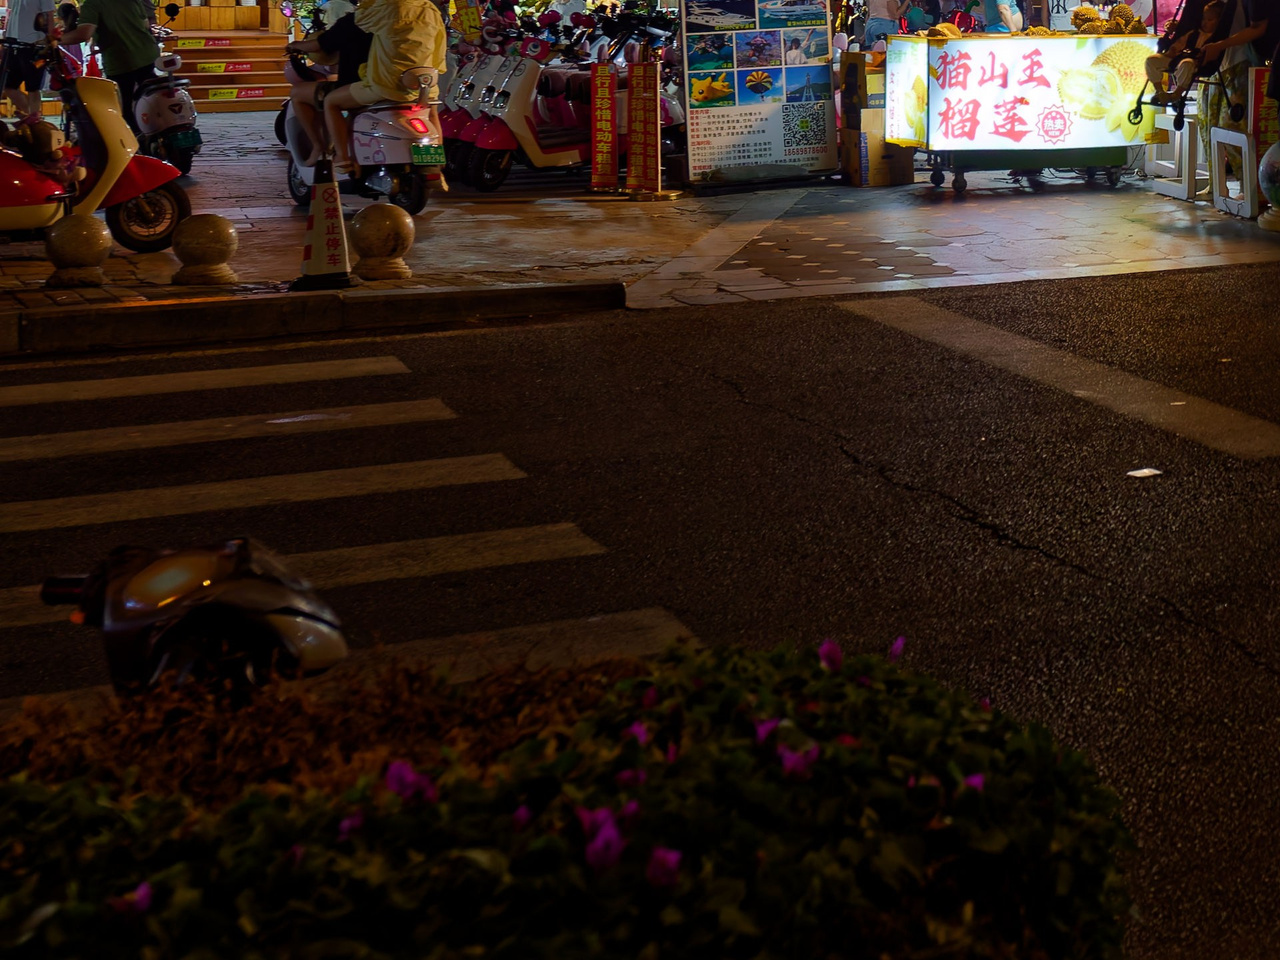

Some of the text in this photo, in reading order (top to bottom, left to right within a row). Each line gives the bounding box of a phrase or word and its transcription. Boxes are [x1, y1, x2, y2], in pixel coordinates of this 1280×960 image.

[937, 48, 1052, 90] 猫山王
[938, 96, 1033, 143] 榴莲
[1043, 118, 1065, 131] 热卖
[784, 146, 828, 157] 18689878600
[323, 207, 342, 267] 禁止停车
